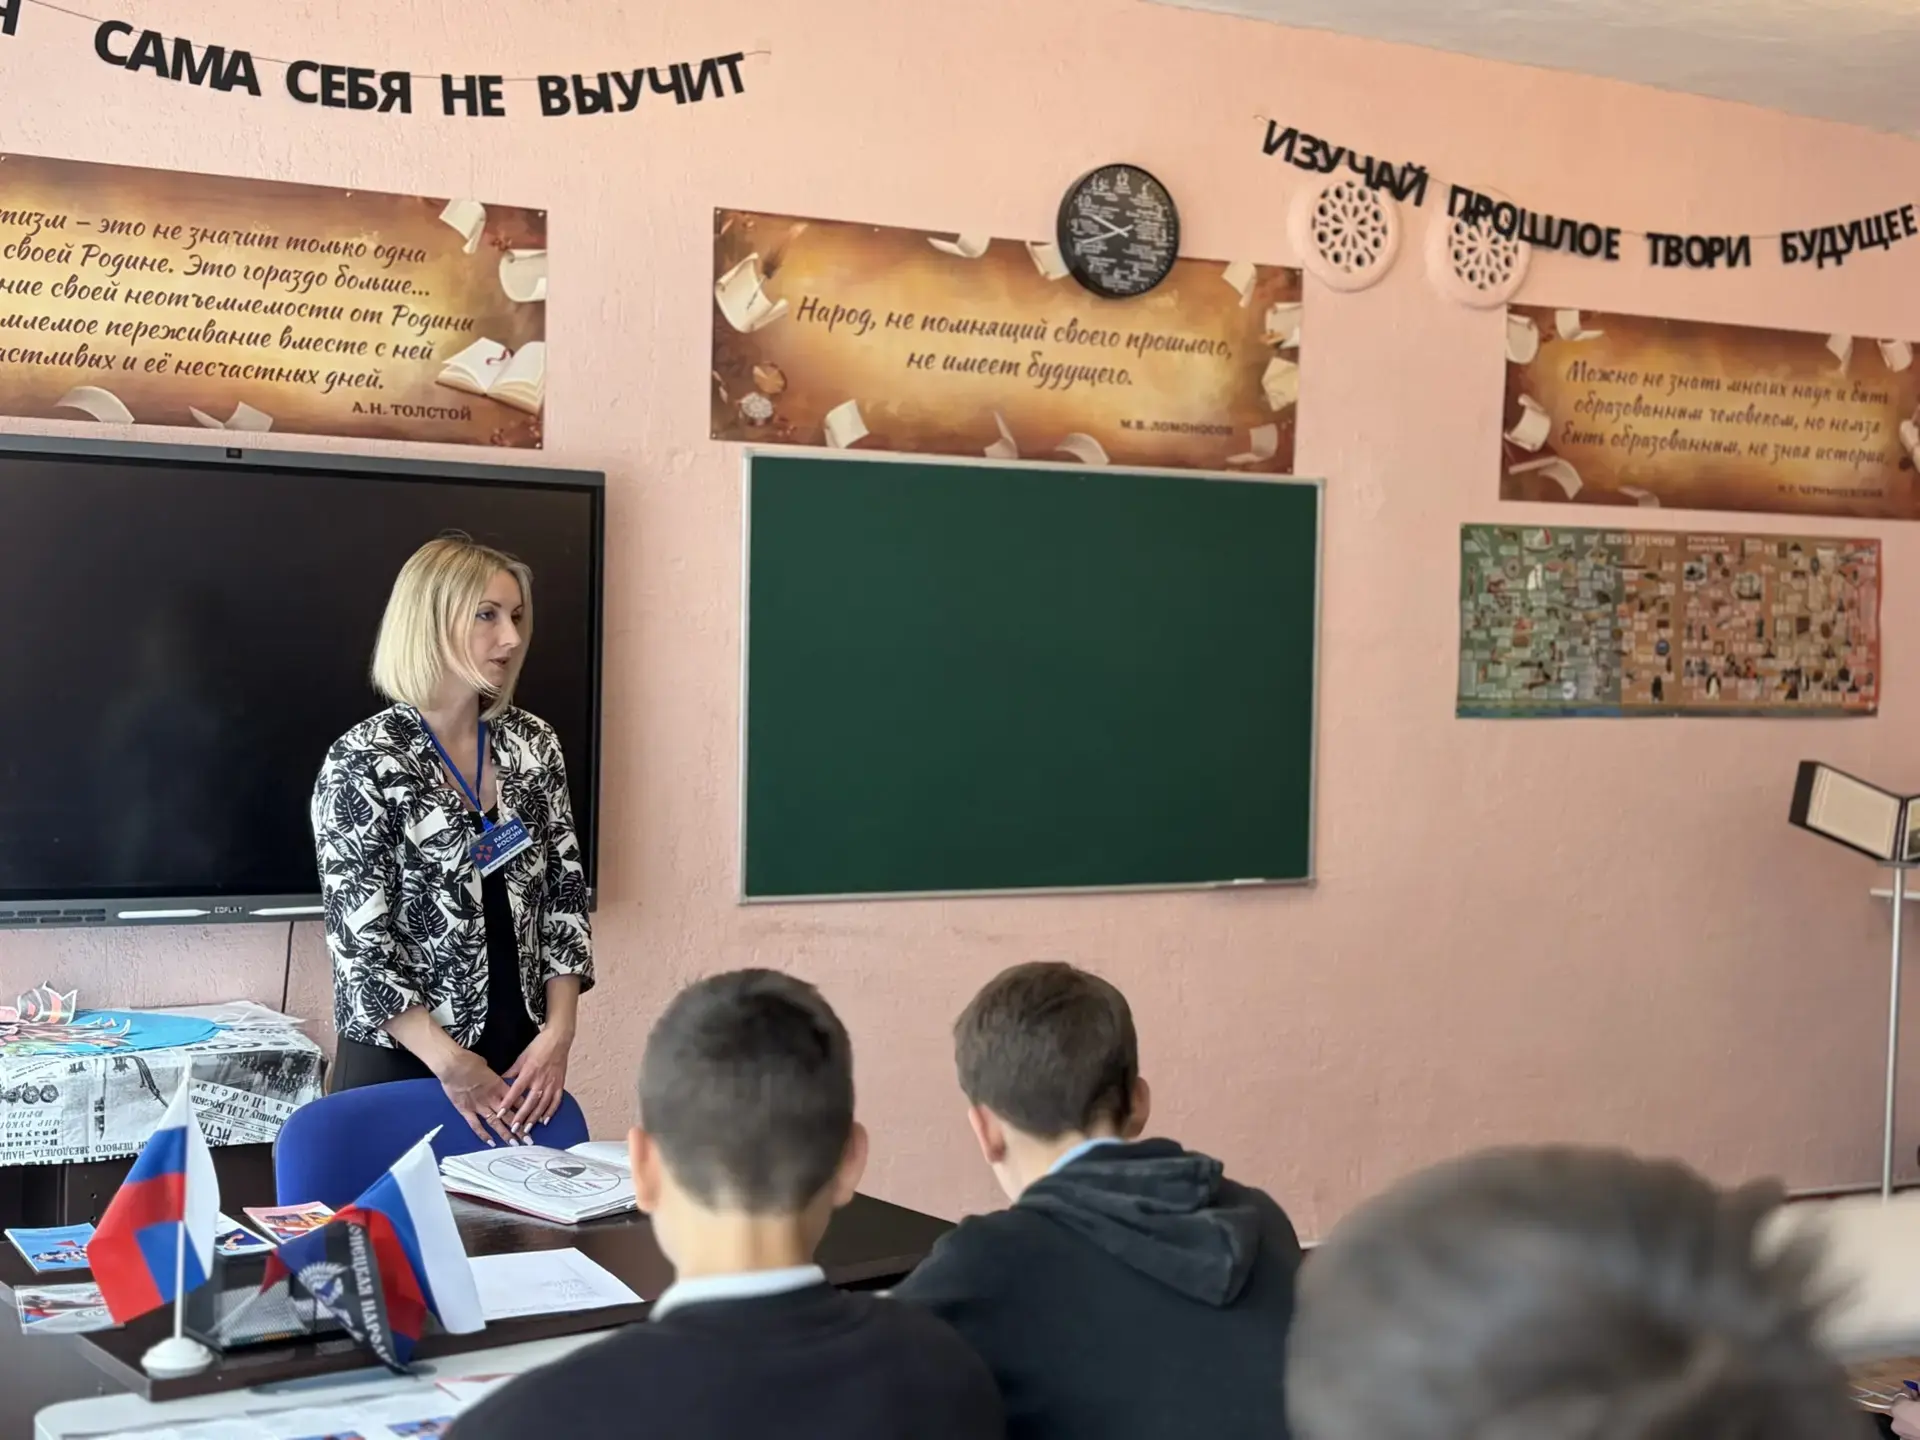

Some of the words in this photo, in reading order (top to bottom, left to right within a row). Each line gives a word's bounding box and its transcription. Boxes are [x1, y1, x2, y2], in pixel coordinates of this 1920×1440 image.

[94, 20, 261, 96] САМА
[286, 60, 411, 114] СЕБЯ
[441, 74, 505, 117] НЕ
[537, 52, 745, 117] ВЫУЧИТ
[1262, 120, 1428, 207] ИЗУЧАЙ
[1447, 184, 1621, 261] ПРОШЛОЕ
[1646, 231, 1751, 269] ТВОРИ
[1781, 204, 1918, 269] БУДУЩЕЕ
[3, 236, 74, 264] своей
[80, 243, 174, 277] Родине.
[183, 254, 236, 278] Это
[243, 263, 328, 294] гораздо
[335, 264, 430, 296] больше...
[97, 218, 146, 236] это
[152, 222, 182, 240] не
[182, 226, 279, 250] значит
[286, 234, 366, 258] только
[373, 243, 427, 269] одна
[51, 274, 120, 302] своей
[125, 288, 343, 321] неотъемлемости
[350, 307, 383, 324] от
[105, 318, 271, 347] переживание
[279, 325, 367, 356] вместе
[375, 342, 387, 357] с
[392, 341, 435, 361] ней
[796, 296, 876, 336] Народ,
[885, 312, 915, 330] не
[920, 314, 1048, 344] помнящий
[1053, 317, 1121, 347] своего
[1125, 332, 1232, 360] прошлого,
[122, 355, 135, 371] и
[144, 352, 172, 373] её
[174, 360, 319, 385] несчастных
[321, 368, 384, 394] дней.
[906, 352, 936, 370] не
[942, 354, 1021, 377] имеет
[1026, 350, 1133, 390] будущего.
[1566, 360, 1638, 386] Можно
[1643, 373, 1664, 388] не
[1666, 373, 1720, 397] знать
[1727, 379, 1786, 397] многих
[1792, 384, 1832, 409] наук
[1837, 387, 1846, 401] и
[391, 403, 472, 421] ТОЛСТОЙ
[1804, 416, 1825, 431] но
[1748, 442, 1768, 457] не
[95, 1142, 133, 1153] ПЕРВОГО
[348, 1222, 374, 1296] ОНЕЦКАЯ
